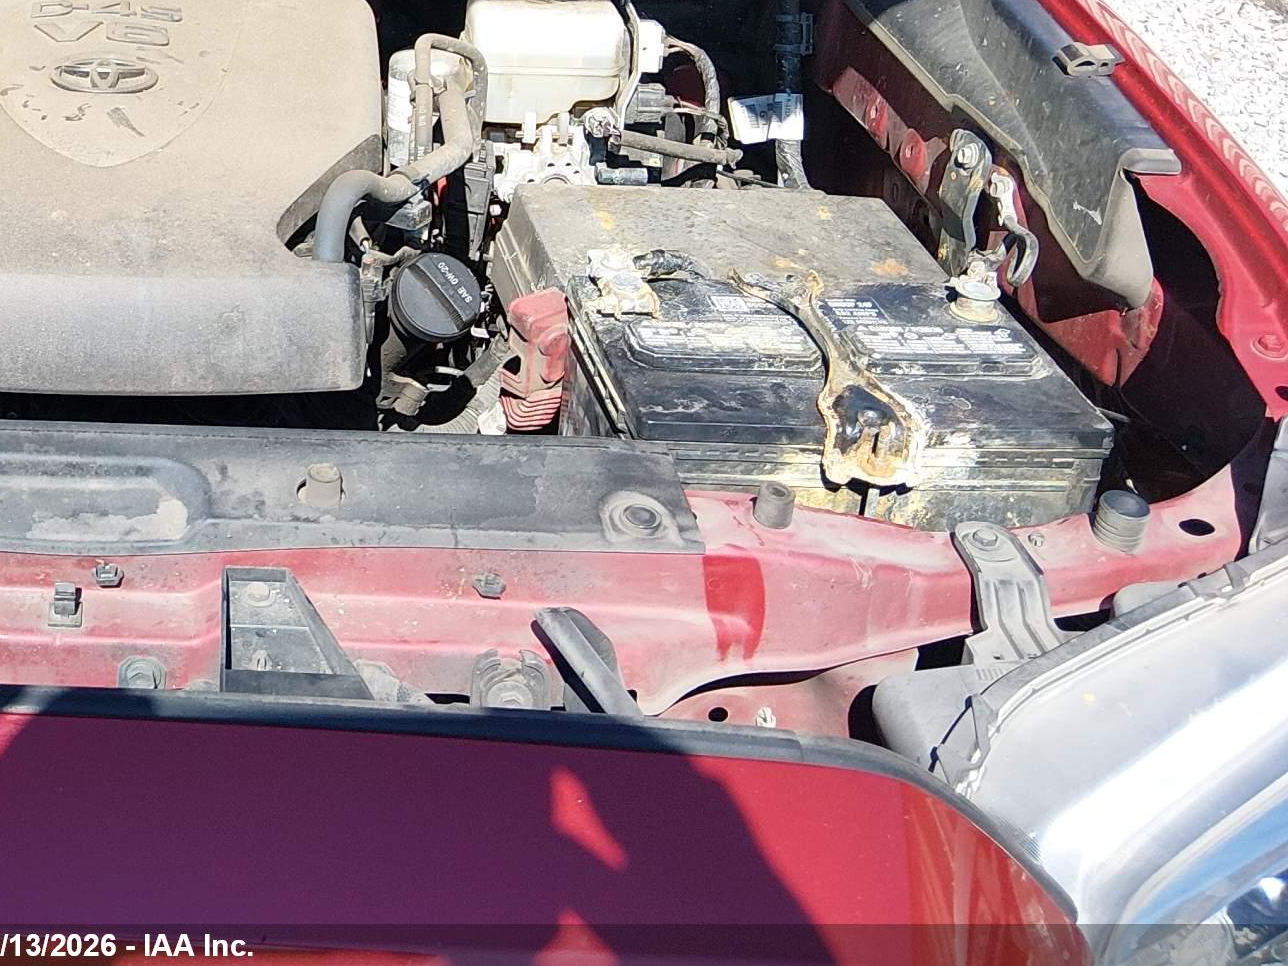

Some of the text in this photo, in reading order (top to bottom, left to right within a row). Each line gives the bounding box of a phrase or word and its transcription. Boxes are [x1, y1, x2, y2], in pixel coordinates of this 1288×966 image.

[32, 20, 171, 46] V6
[437, 261, 473, 303] SAE 0W-20
